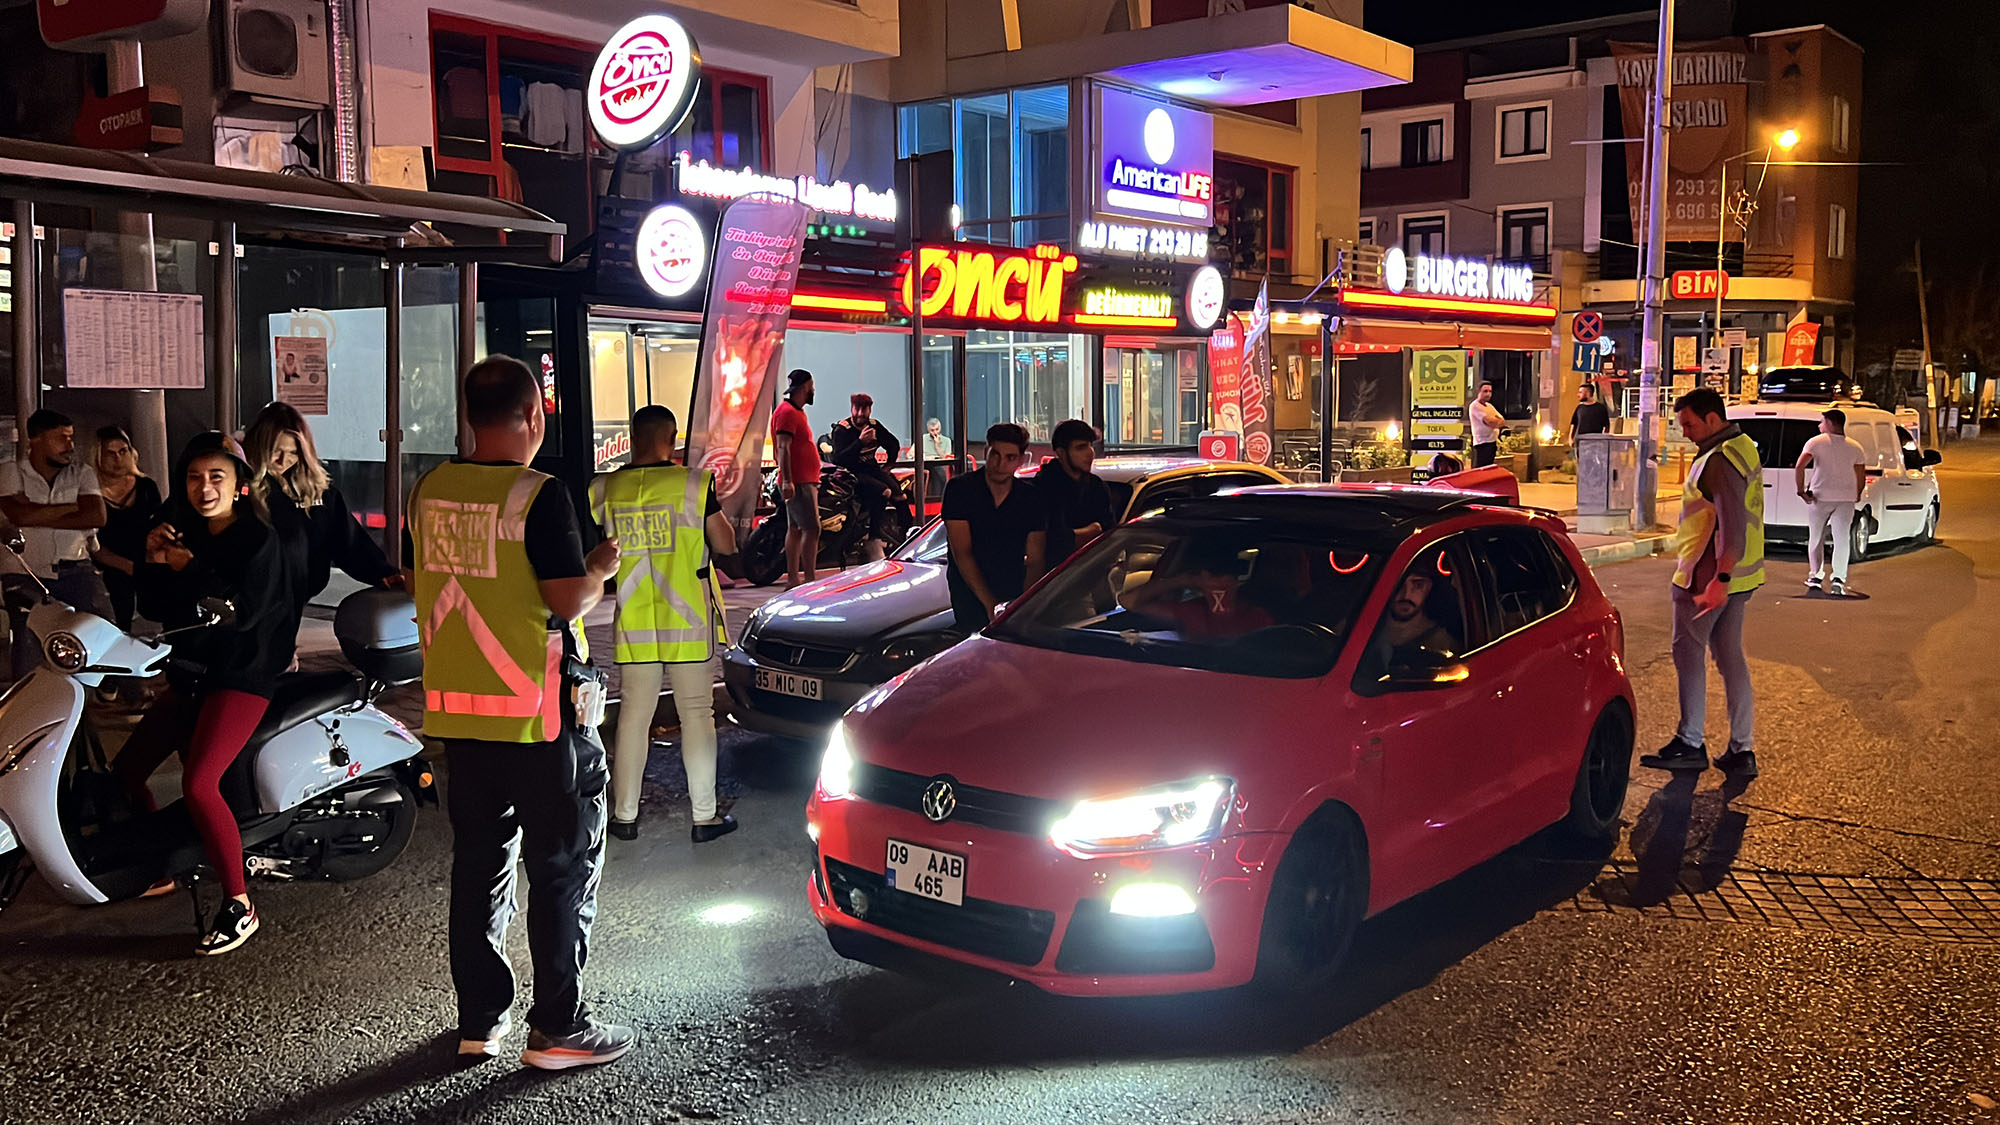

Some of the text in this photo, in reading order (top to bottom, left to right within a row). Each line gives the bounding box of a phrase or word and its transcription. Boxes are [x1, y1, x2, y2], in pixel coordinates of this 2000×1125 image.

[1619, 52, 1746, 88] KAYLARIMIZ
[99, 108, 144, 135] OTOPARK
[1651, 98, 1727, 132] ŞLADI
[731, 246, 752, 260] En
[1417, 255, 1534, 302] BURGER KING
[1419, 354, 1457, 384] BG
[1412, 408, 1432, 417] GENEL
[755, 670, 770, 688] 35
[801, 680, 818, 697] 09
[889, 843, 962, 878] 09 AAB
[914, 872, 943, 897] 465
